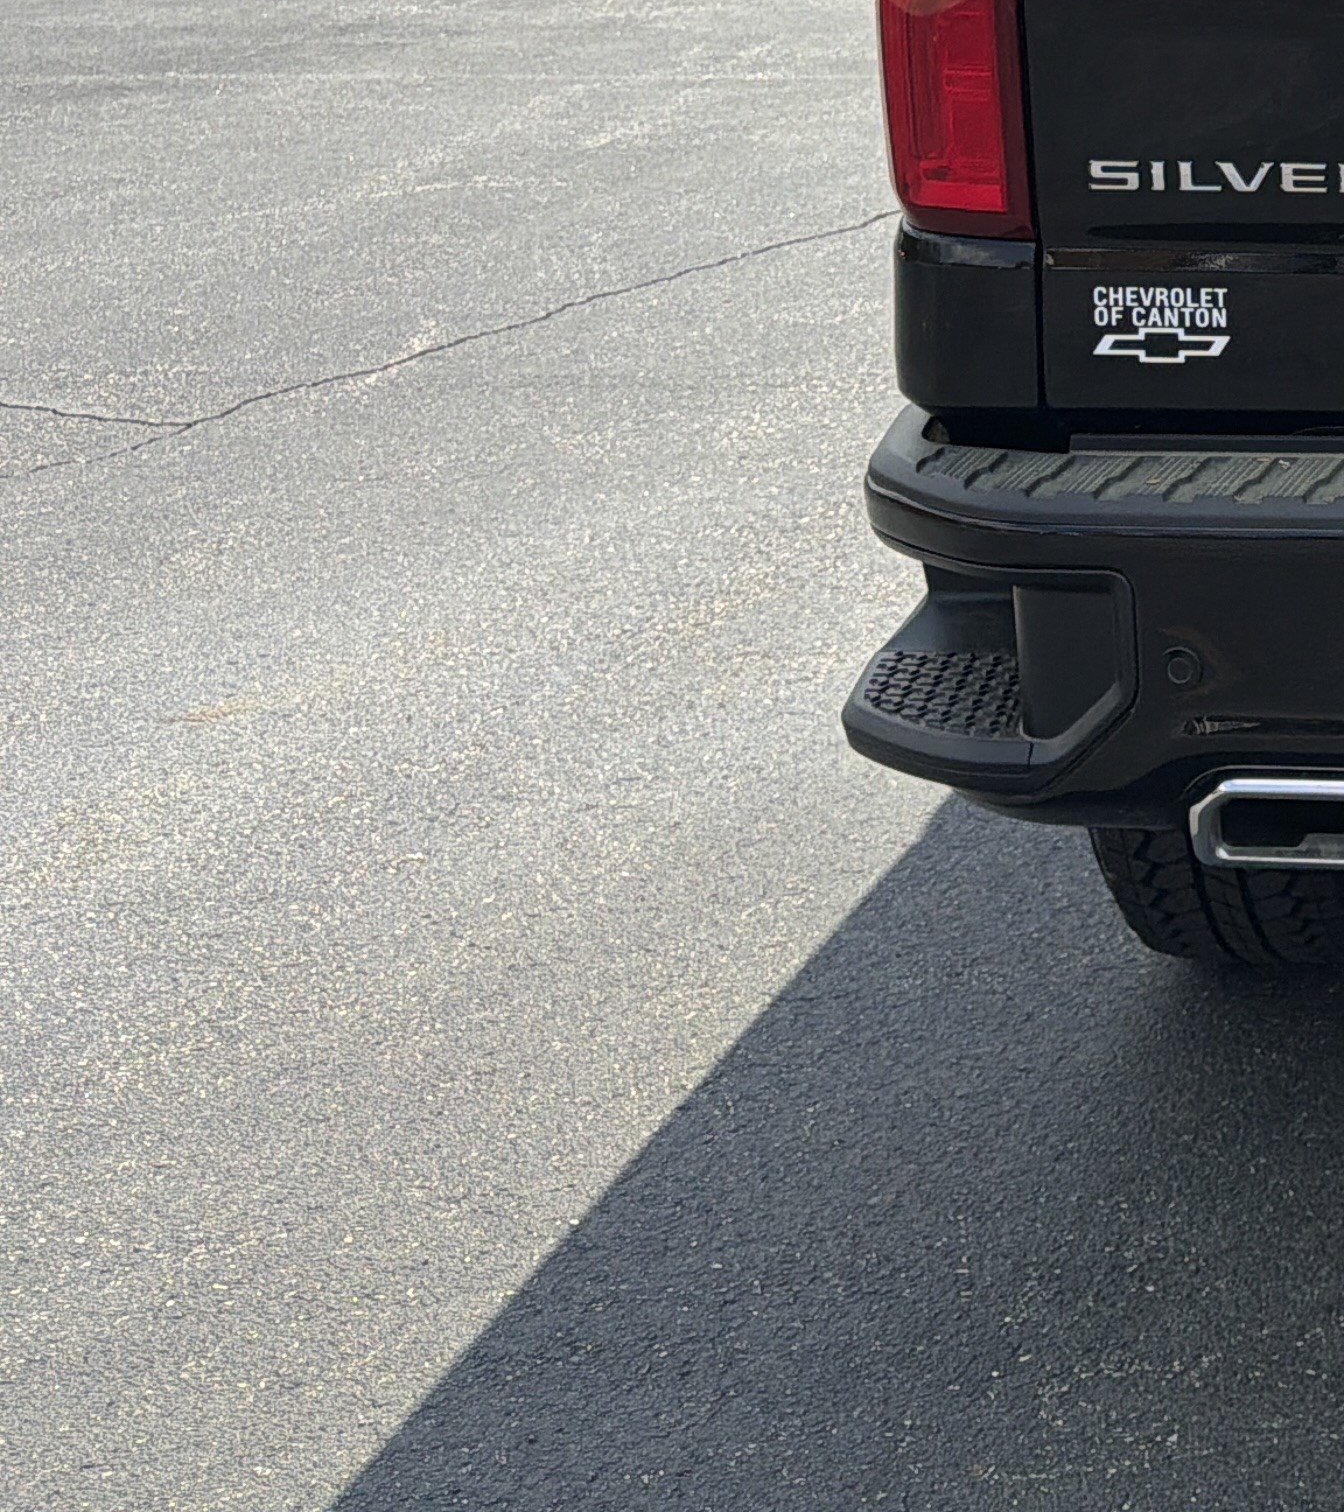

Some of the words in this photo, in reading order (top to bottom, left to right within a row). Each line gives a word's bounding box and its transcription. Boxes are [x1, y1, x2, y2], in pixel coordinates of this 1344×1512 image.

[1093, 286, 1228, 308] CHEVROLET
[1093, 306, 1124, 327] OF
[1131, 307, 1227, 328] CANTON
